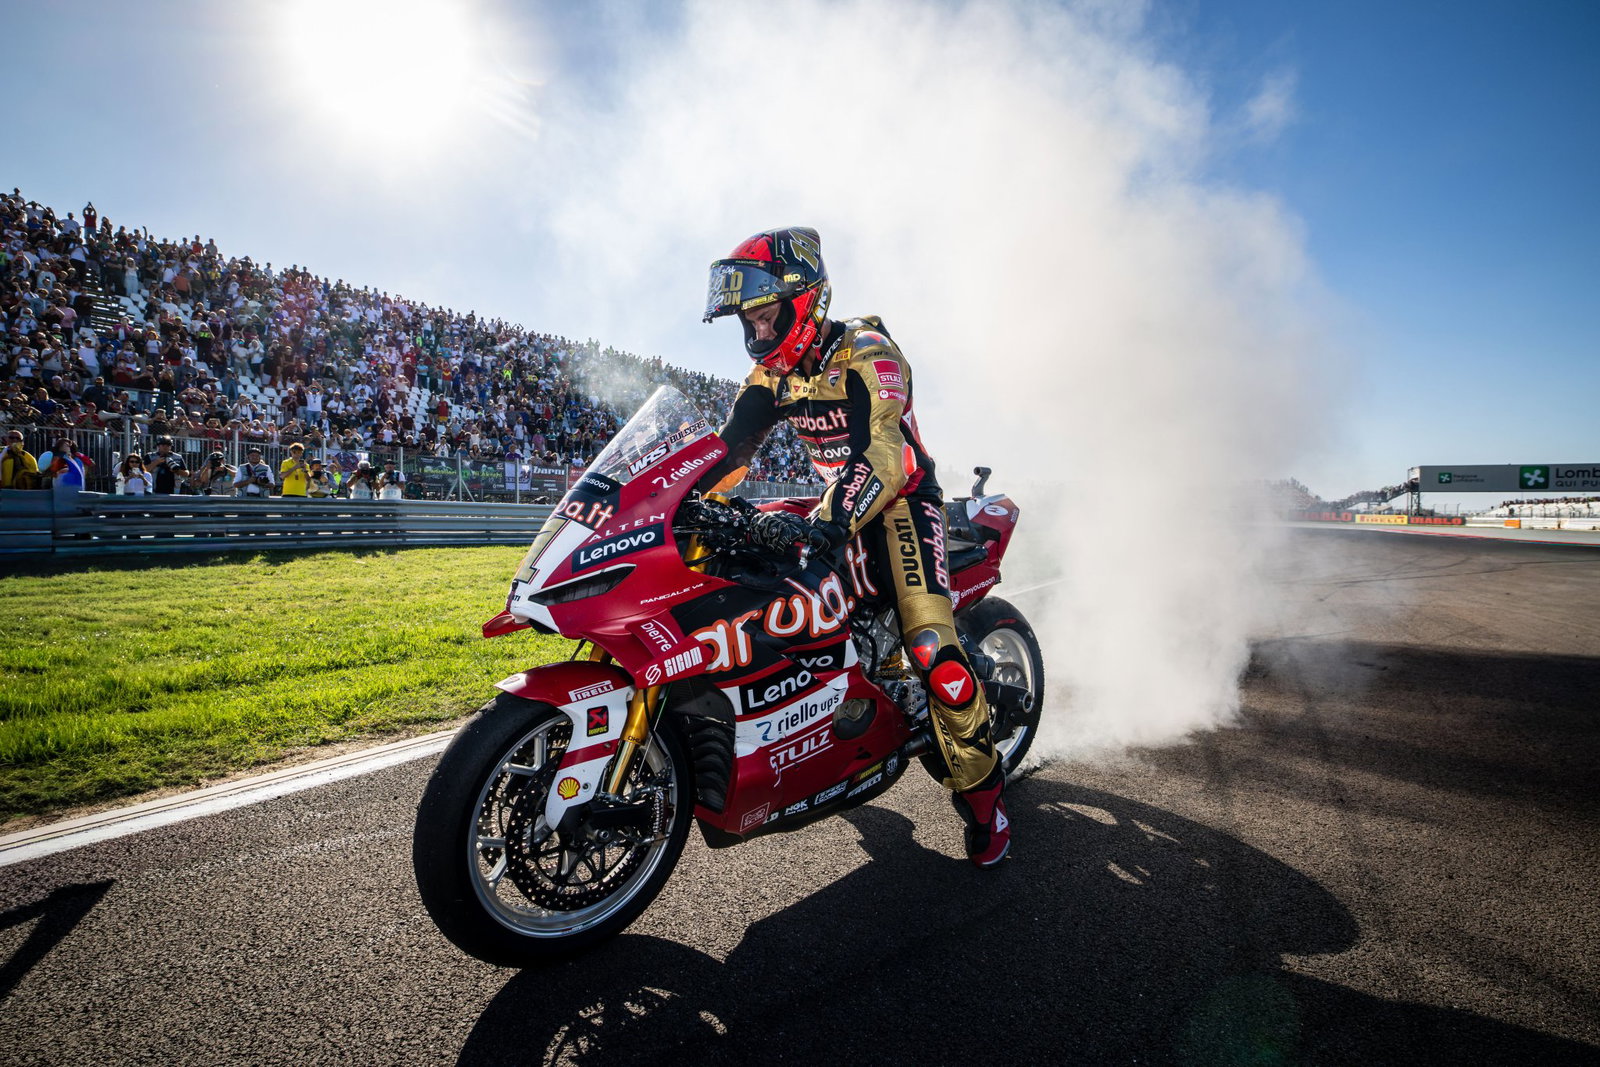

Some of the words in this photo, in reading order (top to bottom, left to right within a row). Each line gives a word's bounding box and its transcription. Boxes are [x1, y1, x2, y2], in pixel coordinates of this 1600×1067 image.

[629, 443, 667, 475] WRS
[670, 457, 704, 481] riello
[703, 448, 721, 461] ups
[842, 462, 871, 511] aruba.it
[855, 482, 880, 517] Lenovo
[1555, 480, 1576, 488] QUI
[588, 513, 665, 542] ALTEN
[1410, 516, 1462, 525] DIABLO
[579, 531, 656, 565] Lenovo
[893, 518, 922, 588] DUCATI
[641, 621, 672, 652] Dierre
[568, 680, 614, 702] PIRELLI
[747, 653, 834, 709] Lenovo
[777, 702, 818, 735] riello
[820, 691, 840, 712] ups
[785, 799, 808, 813] NGK
